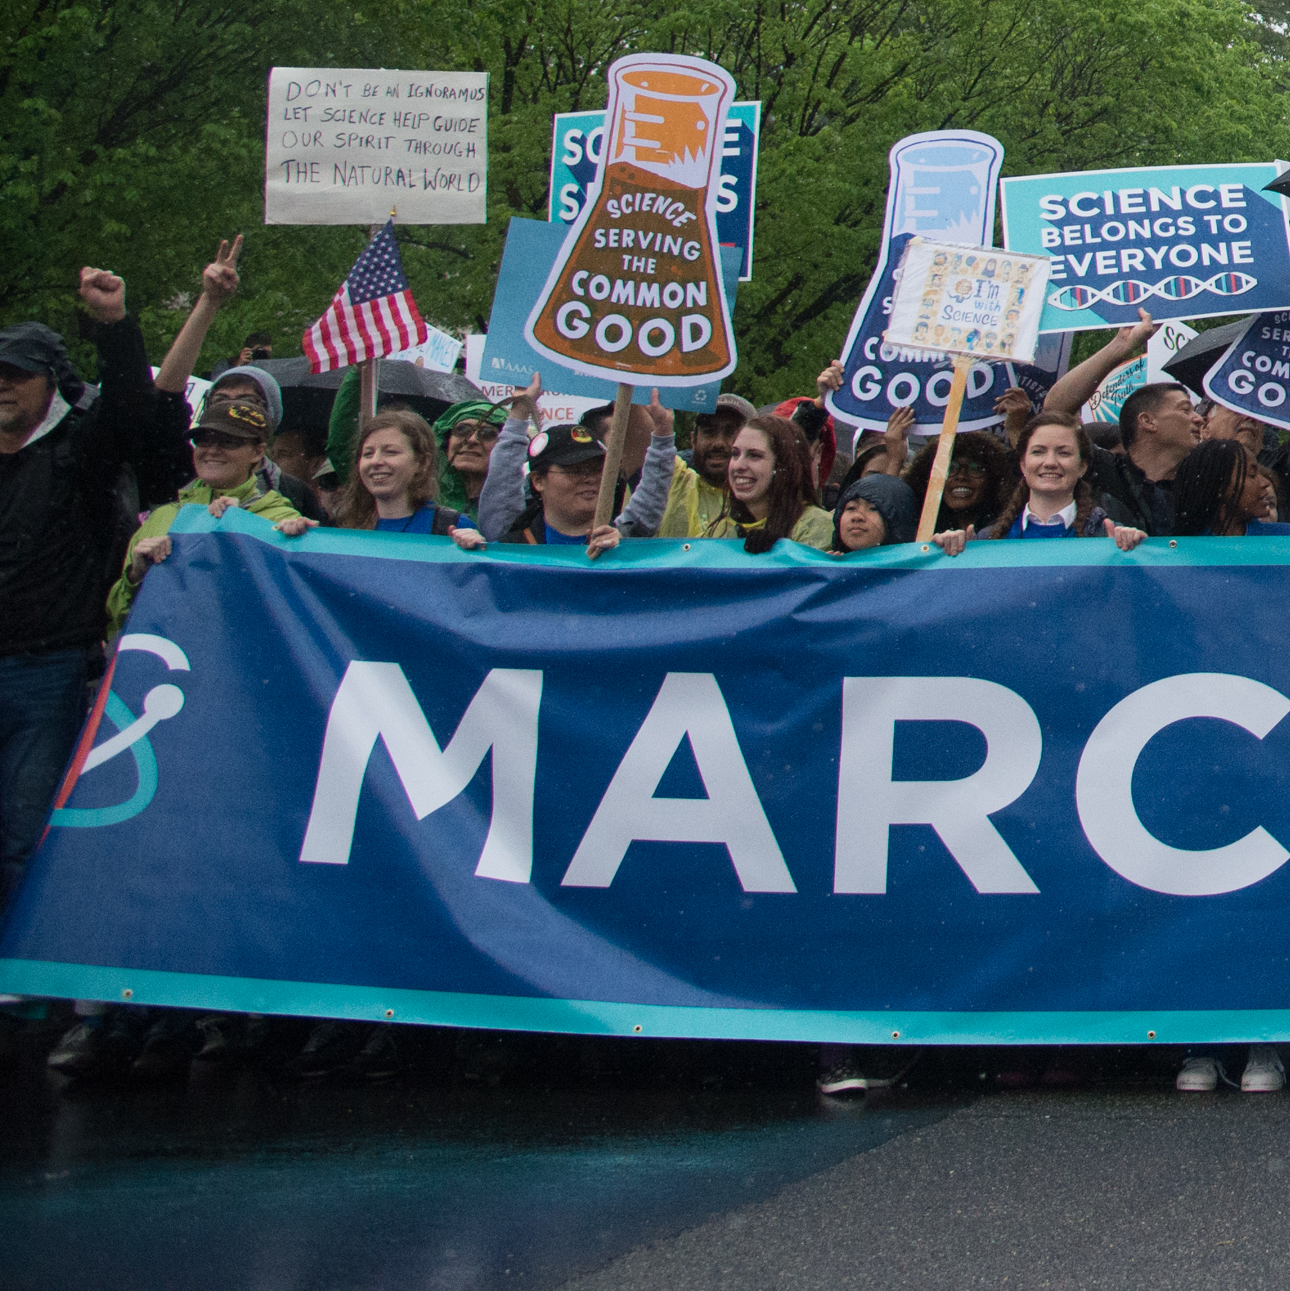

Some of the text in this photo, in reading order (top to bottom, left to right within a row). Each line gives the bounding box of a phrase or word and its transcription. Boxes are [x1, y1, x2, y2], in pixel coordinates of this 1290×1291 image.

[287, 79, 486, 102] DON'T BE AN IGNORAMUS
[284, 106, 480, 133] LET SCIENCE HELP GUIDE
[282, 131, 476, 157] OUR SPIRIT THROUGH
[280, 159, 480, 192] THE NATURAL WORLD
[607, 192, 697, 227] SCIENCE
[1039, 183, 1247, 220] SCIENCE
[593, 228, 701, 260] SERVING
[1041, 214, 1247, 248] BELONGS TO
[622, 255, 657, 274] THE
[1049, 240, 1254, 280] EVERYONE
[571, 270, 707, 309] COMMON
[973, 278, 1000, 299] I'm
[556, 300, 712, 357] GOOD
[852, 362, 994, 407] GOOD
